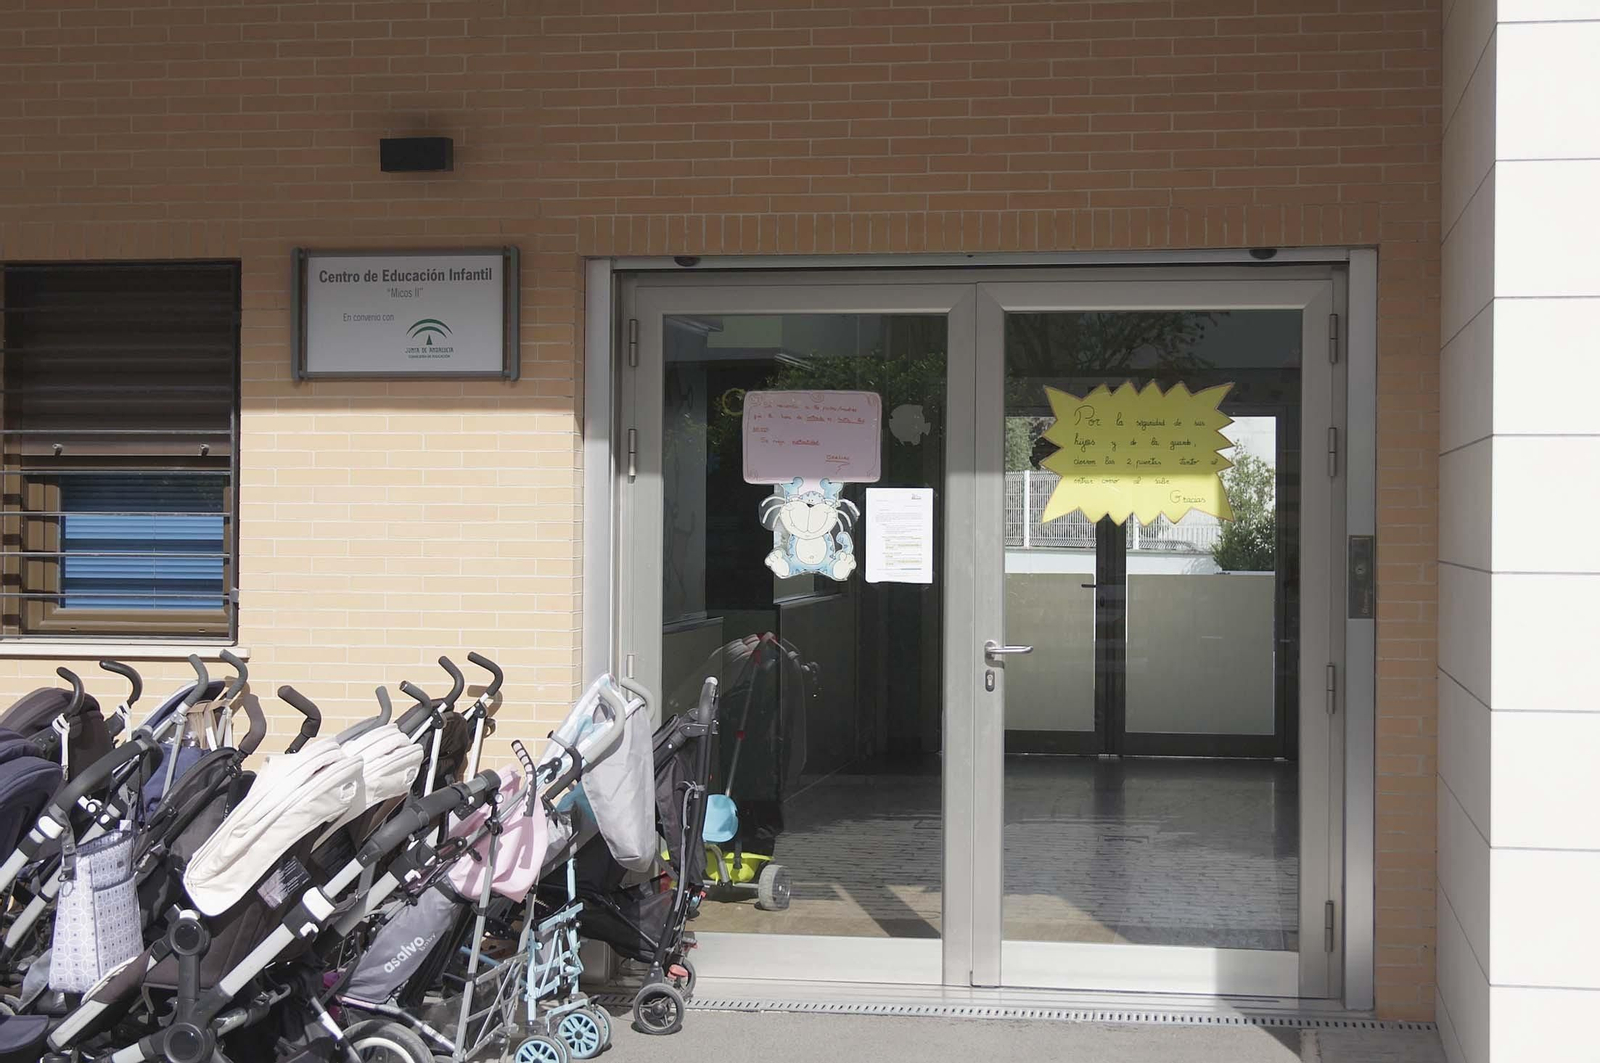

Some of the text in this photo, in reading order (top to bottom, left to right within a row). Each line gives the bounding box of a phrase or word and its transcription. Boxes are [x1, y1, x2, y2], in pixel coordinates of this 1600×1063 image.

[319, 267, 492, 283] Centro de Educación Infantil
[343, 312, 394, 322] En convenio con
[1074, 405, 1101, 426] Por
[1116, 412, 1124, 426] la
[1136, 418, 1165, 431] seguridad
[1174, 418, 1182, 426] de
[1074, 433, 1095, 453] hijos
[1111, 441, 1117, 452] y
[1151, 437, 1159, 446] la
[1104, 456, 1115, 465] las
[1135, 457, 1162, 469] puertas
[1179, 457, 1200, 465] tanto
[1073, 476, 1094, 484] entrar
[1132, 475, 1142, 484] al
[1154, 477, 1170, 485] salir
[1169, 489, 1206, 504] Gracias
[384, 936, 425, 973] asalvo
